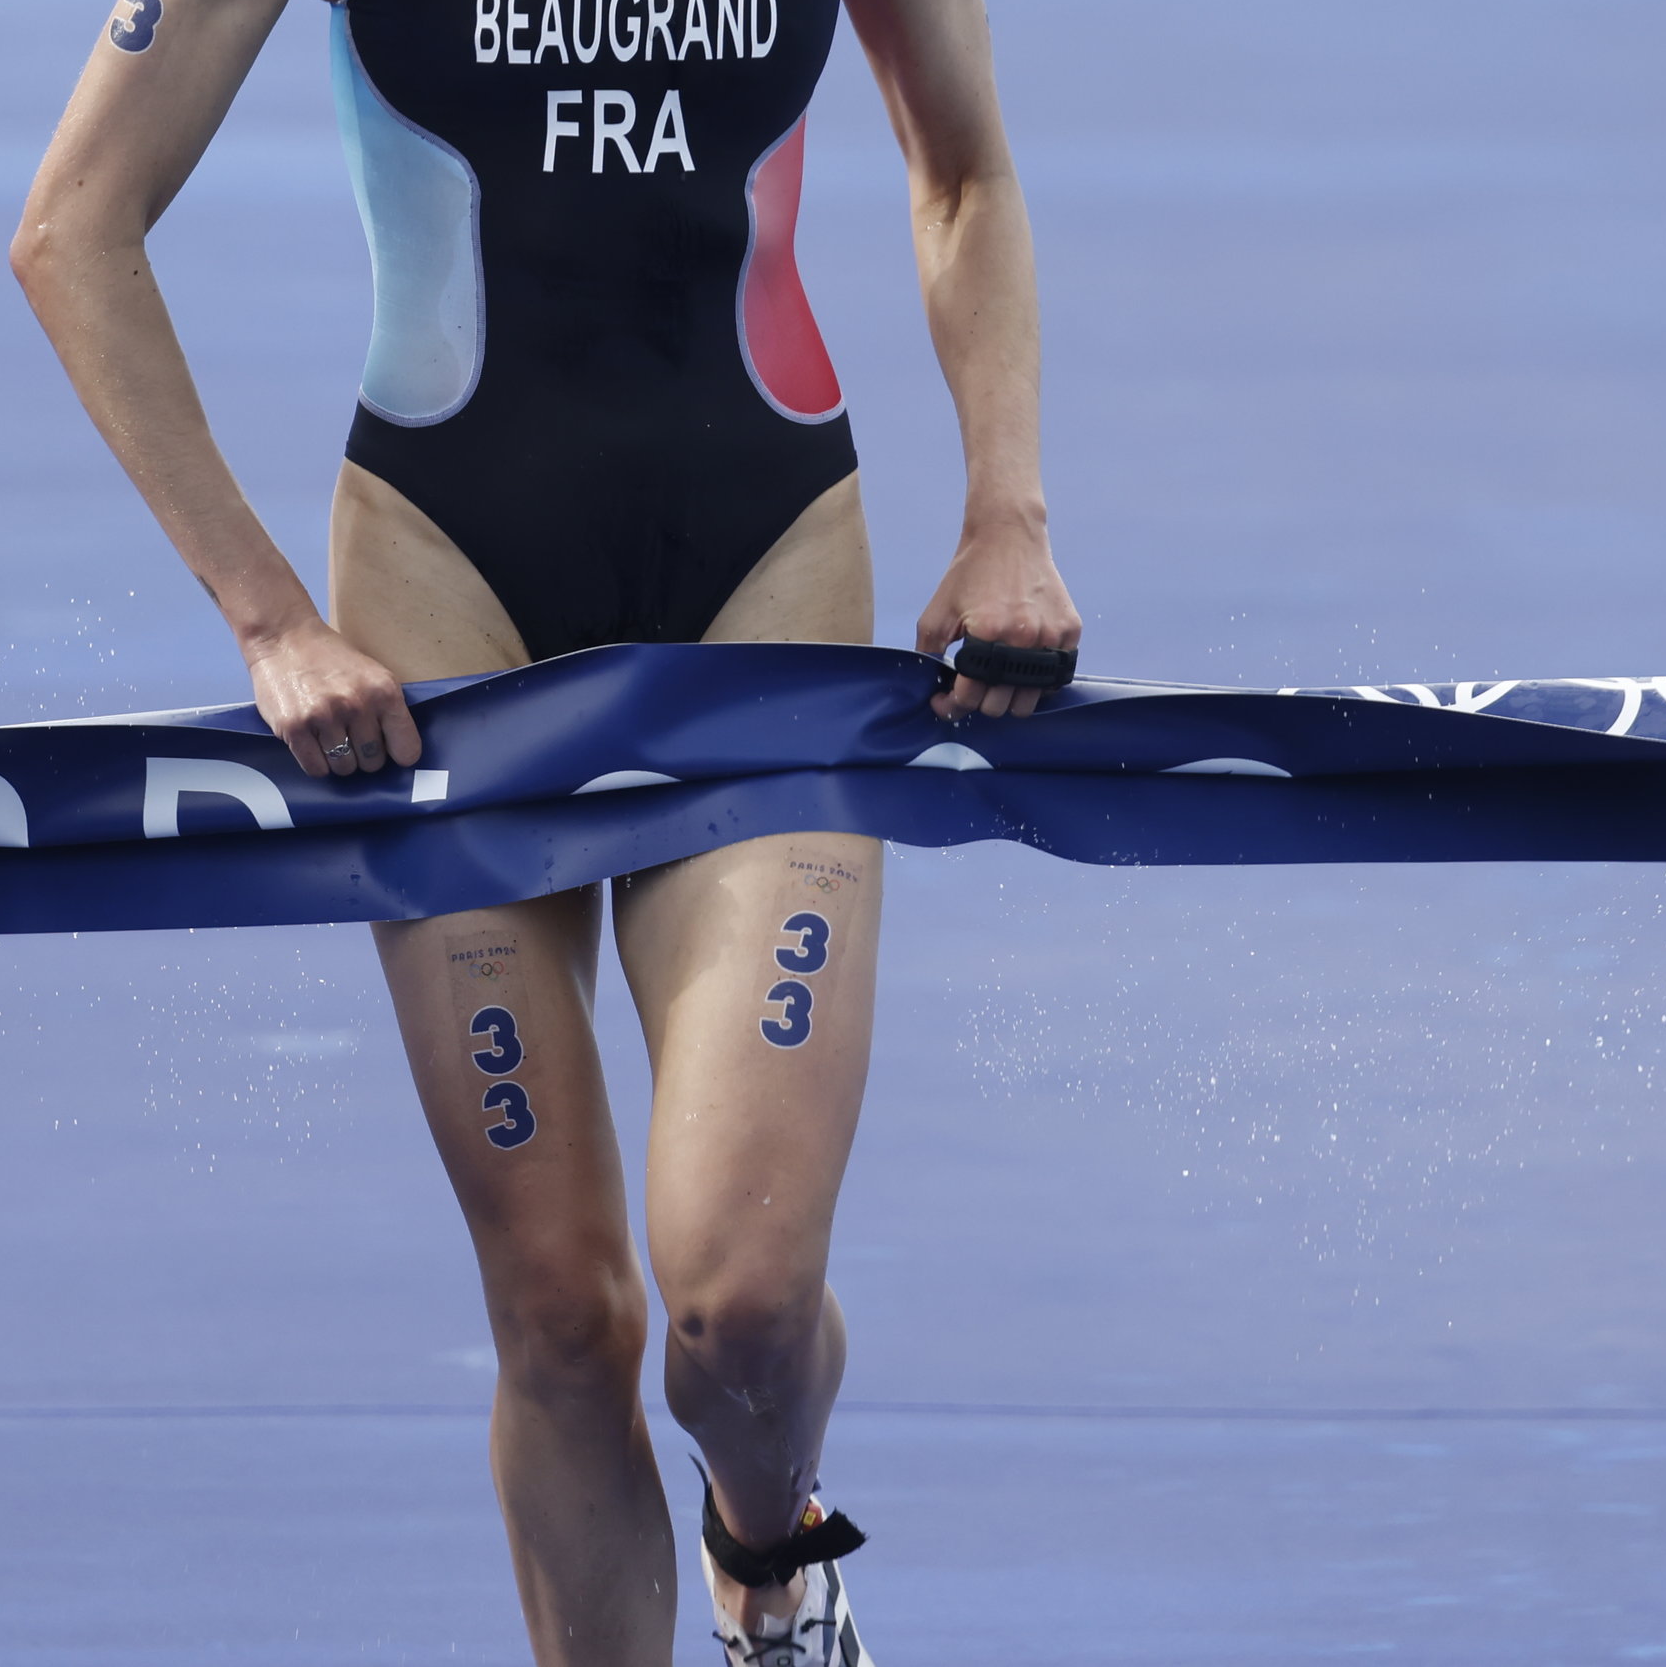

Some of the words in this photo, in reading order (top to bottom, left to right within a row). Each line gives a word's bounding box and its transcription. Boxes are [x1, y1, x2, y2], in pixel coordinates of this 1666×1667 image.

[543, 89, 695, 173] FRA
[790, 861, 825, 872] PARIS
[451, 949, 484, 962] PARIS
